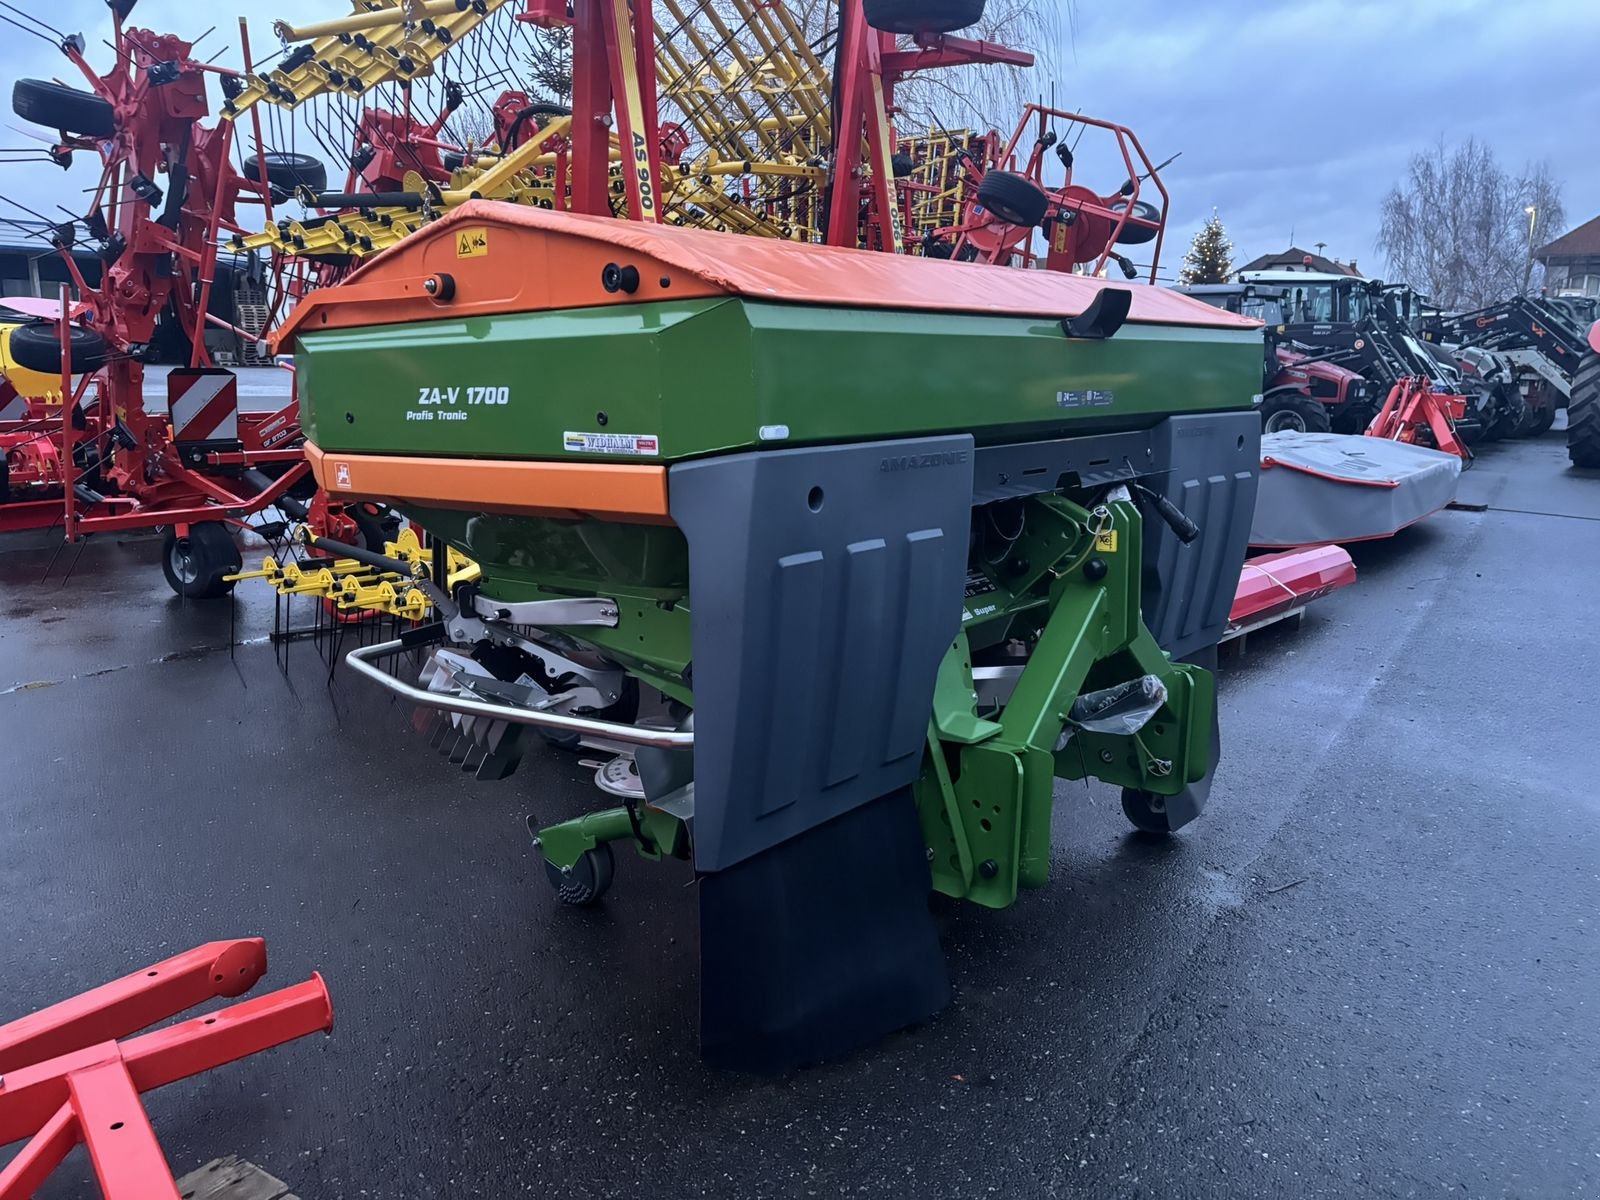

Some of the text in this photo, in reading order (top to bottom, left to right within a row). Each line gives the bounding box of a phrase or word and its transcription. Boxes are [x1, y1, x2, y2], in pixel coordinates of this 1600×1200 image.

[632, 131, 647, 162] AS
[637, 167, 654, 210] 900
[890, 207, 902, 241] 900
[418, 386, 510, 405] ZA-V 1700
[406, 409, 468, 421] Profis Tronic
[880, 449, 969, 473] AMAZONE
[973, 604, 996, 616] Super
